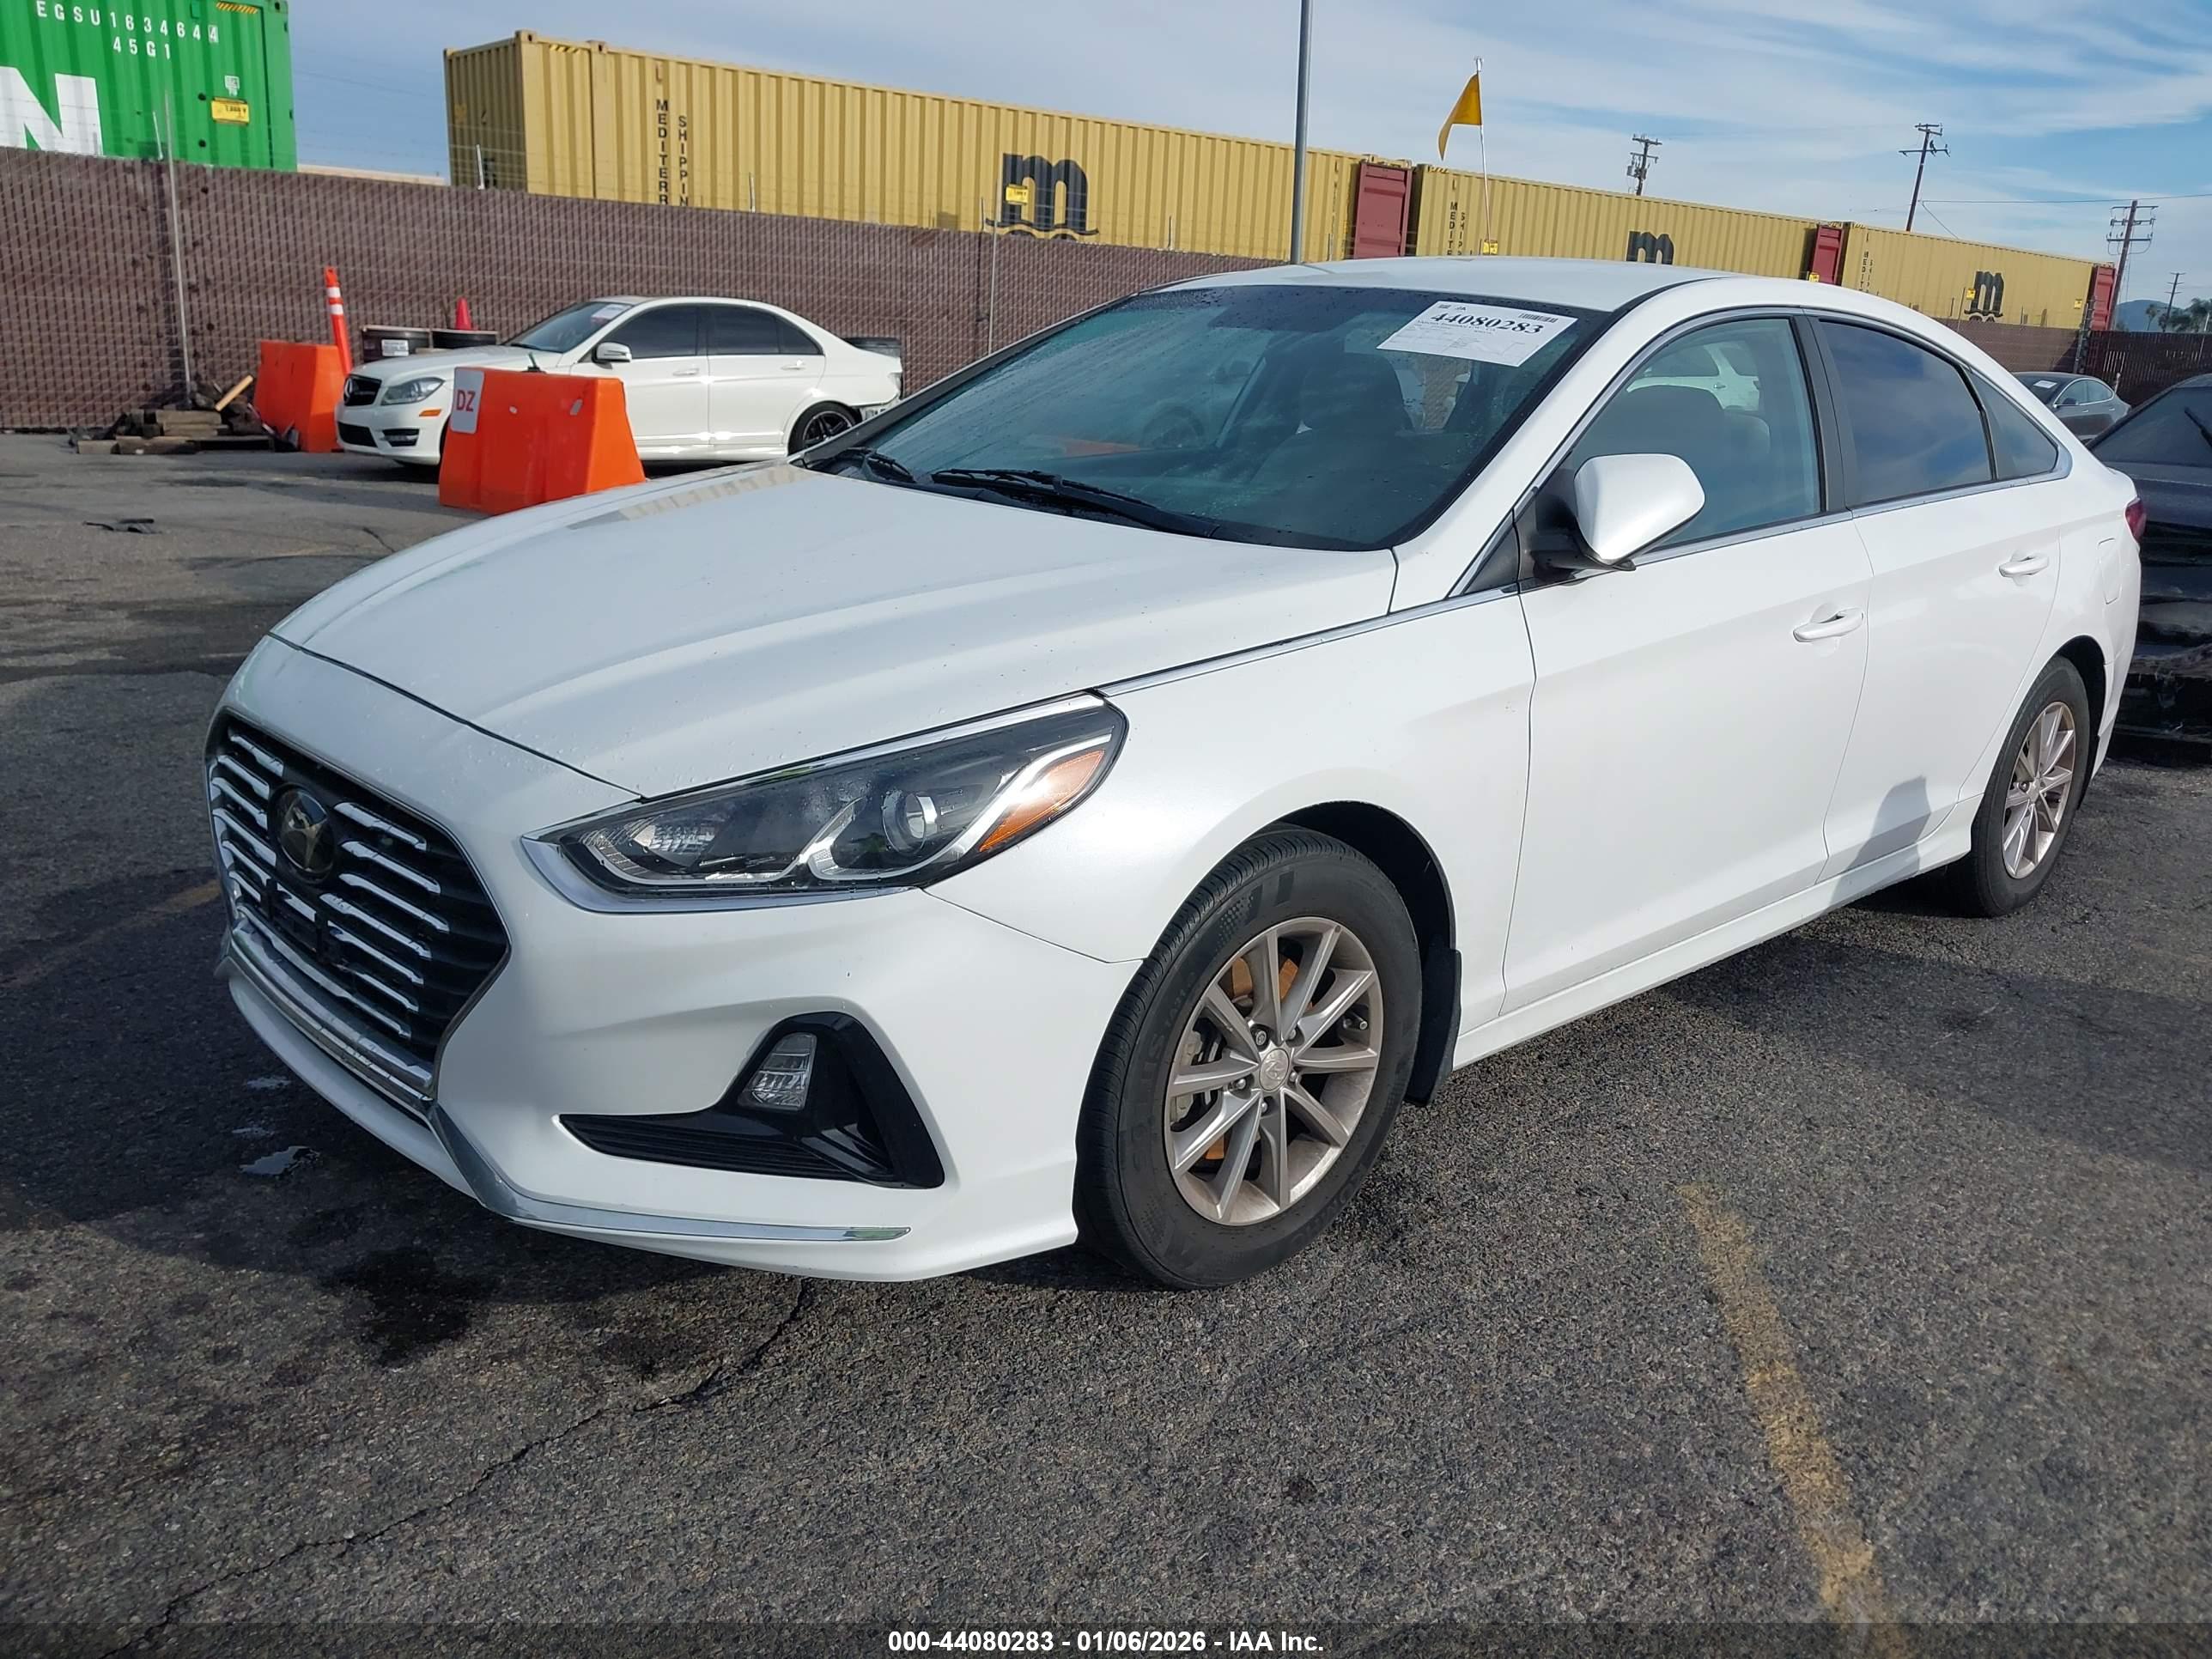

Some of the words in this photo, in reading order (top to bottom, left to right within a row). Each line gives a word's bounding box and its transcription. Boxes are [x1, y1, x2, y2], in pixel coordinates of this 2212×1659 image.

[112, 37, 171, 59] 45G1
[1431, 312, 1544, 334] 44080283
[456, 389, 475, 411] DZ
